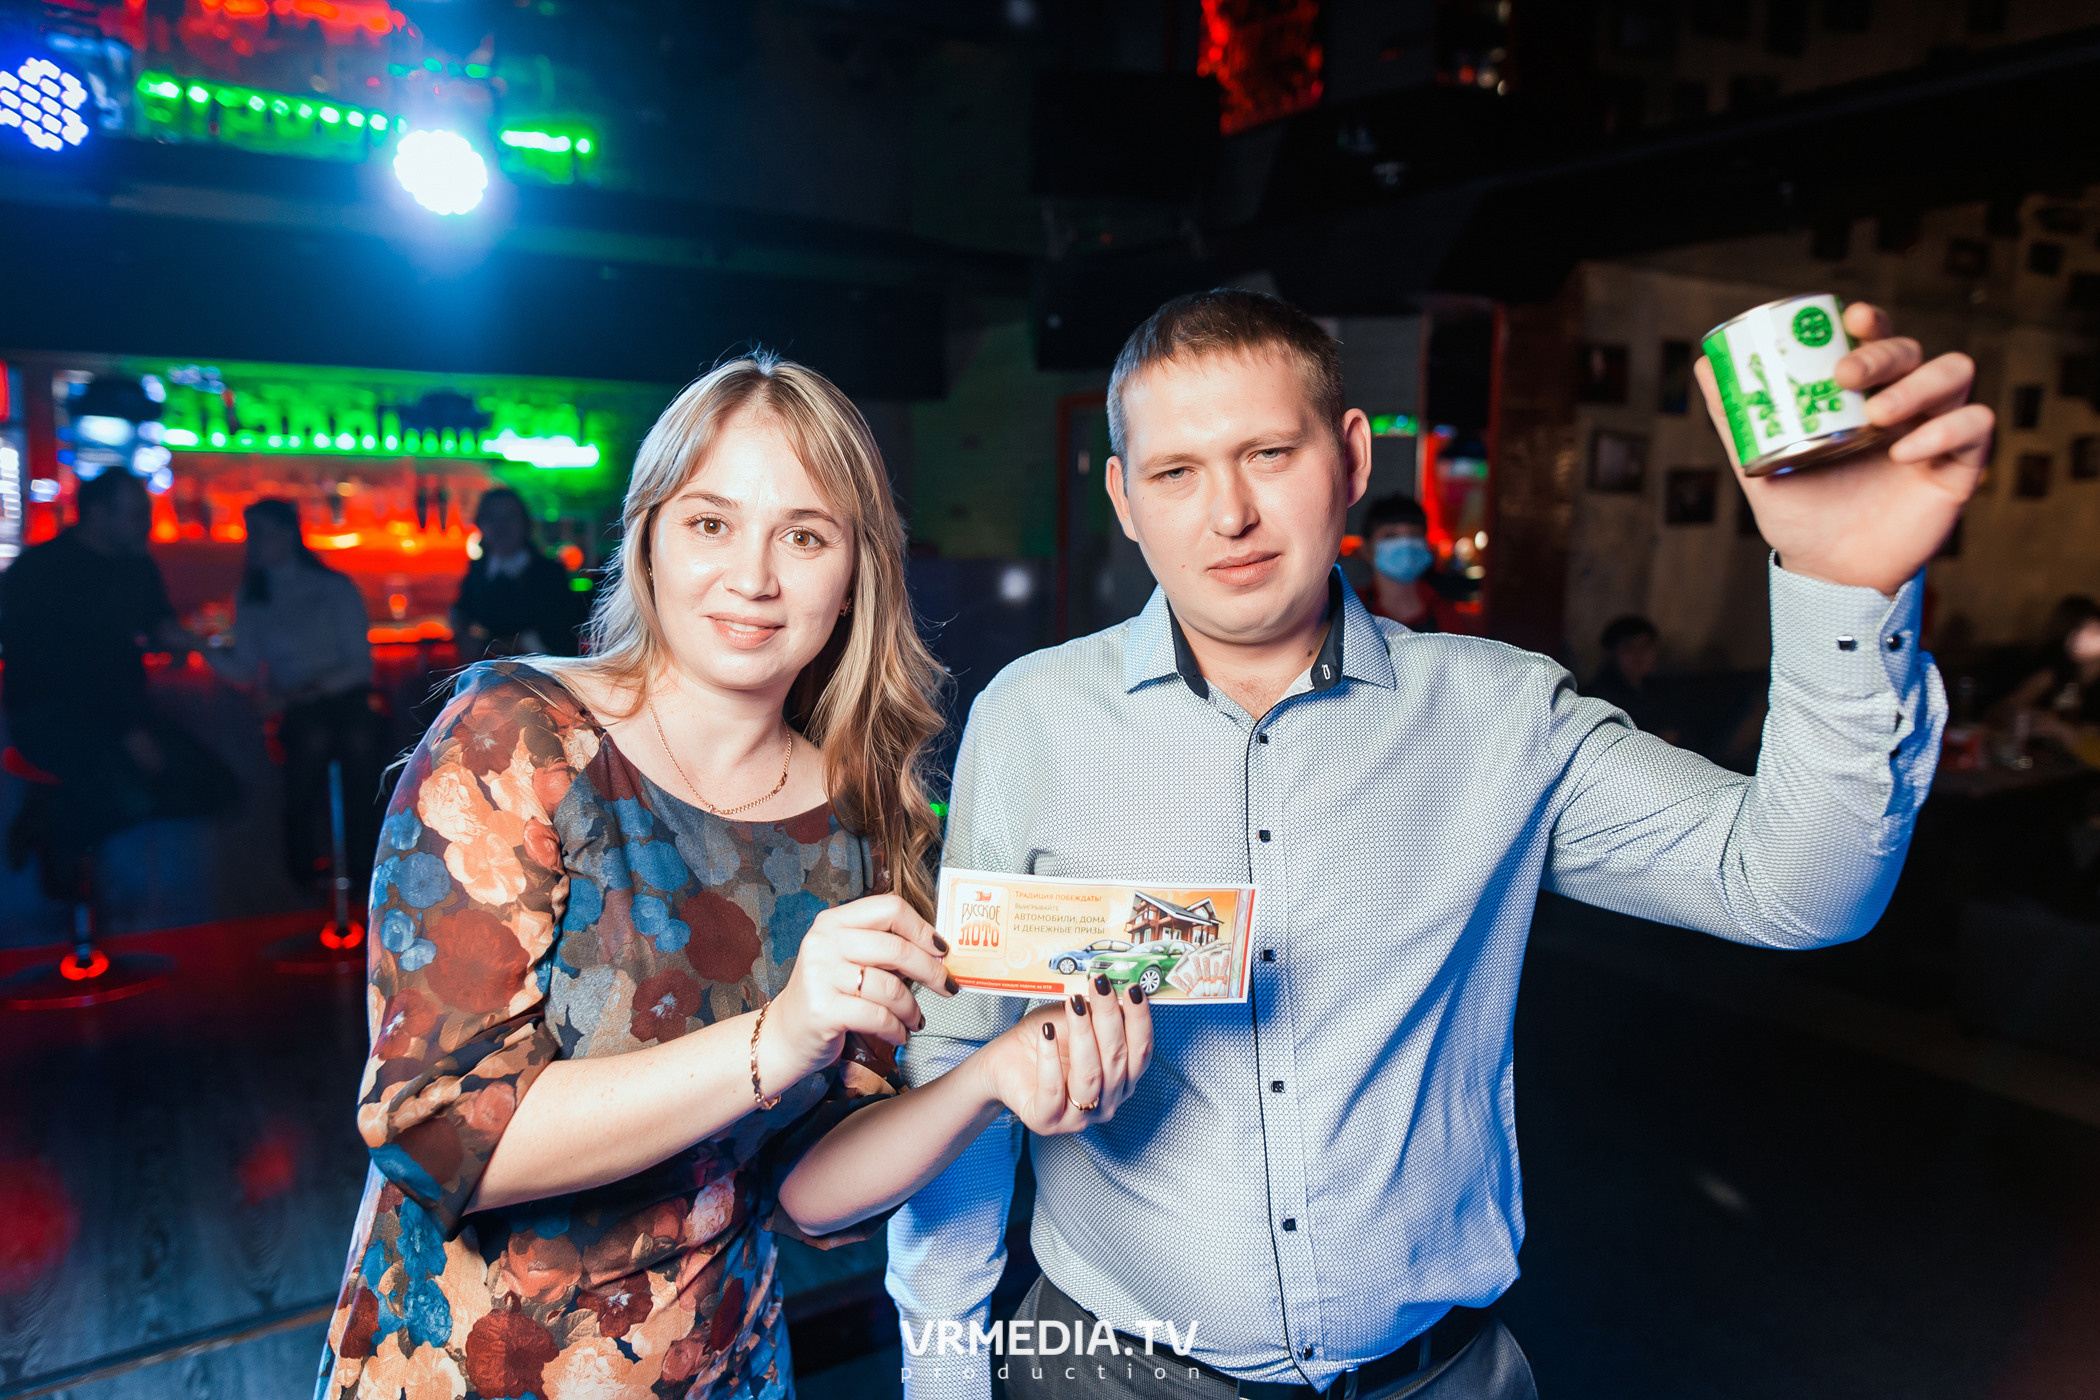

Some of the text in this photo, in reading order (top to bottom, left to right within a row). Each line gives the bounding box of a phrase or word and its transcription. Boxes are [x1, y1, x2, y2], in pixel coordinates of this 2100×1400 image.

[1015, 890, 1102, 902] ТРАДИЦИЯ ПОБЕЖДАТЬ!
[961, 903, 1001, 926] РУССКОЕ
[1014, 912, 1106, 924] АВТОМОБИЛИ, ДОМА
[958, 921, 1000, 947] ЛОТО
[1013, 924, 1105, 935] И ДЕНЕЖНЫЕ ПРИЗЫ
